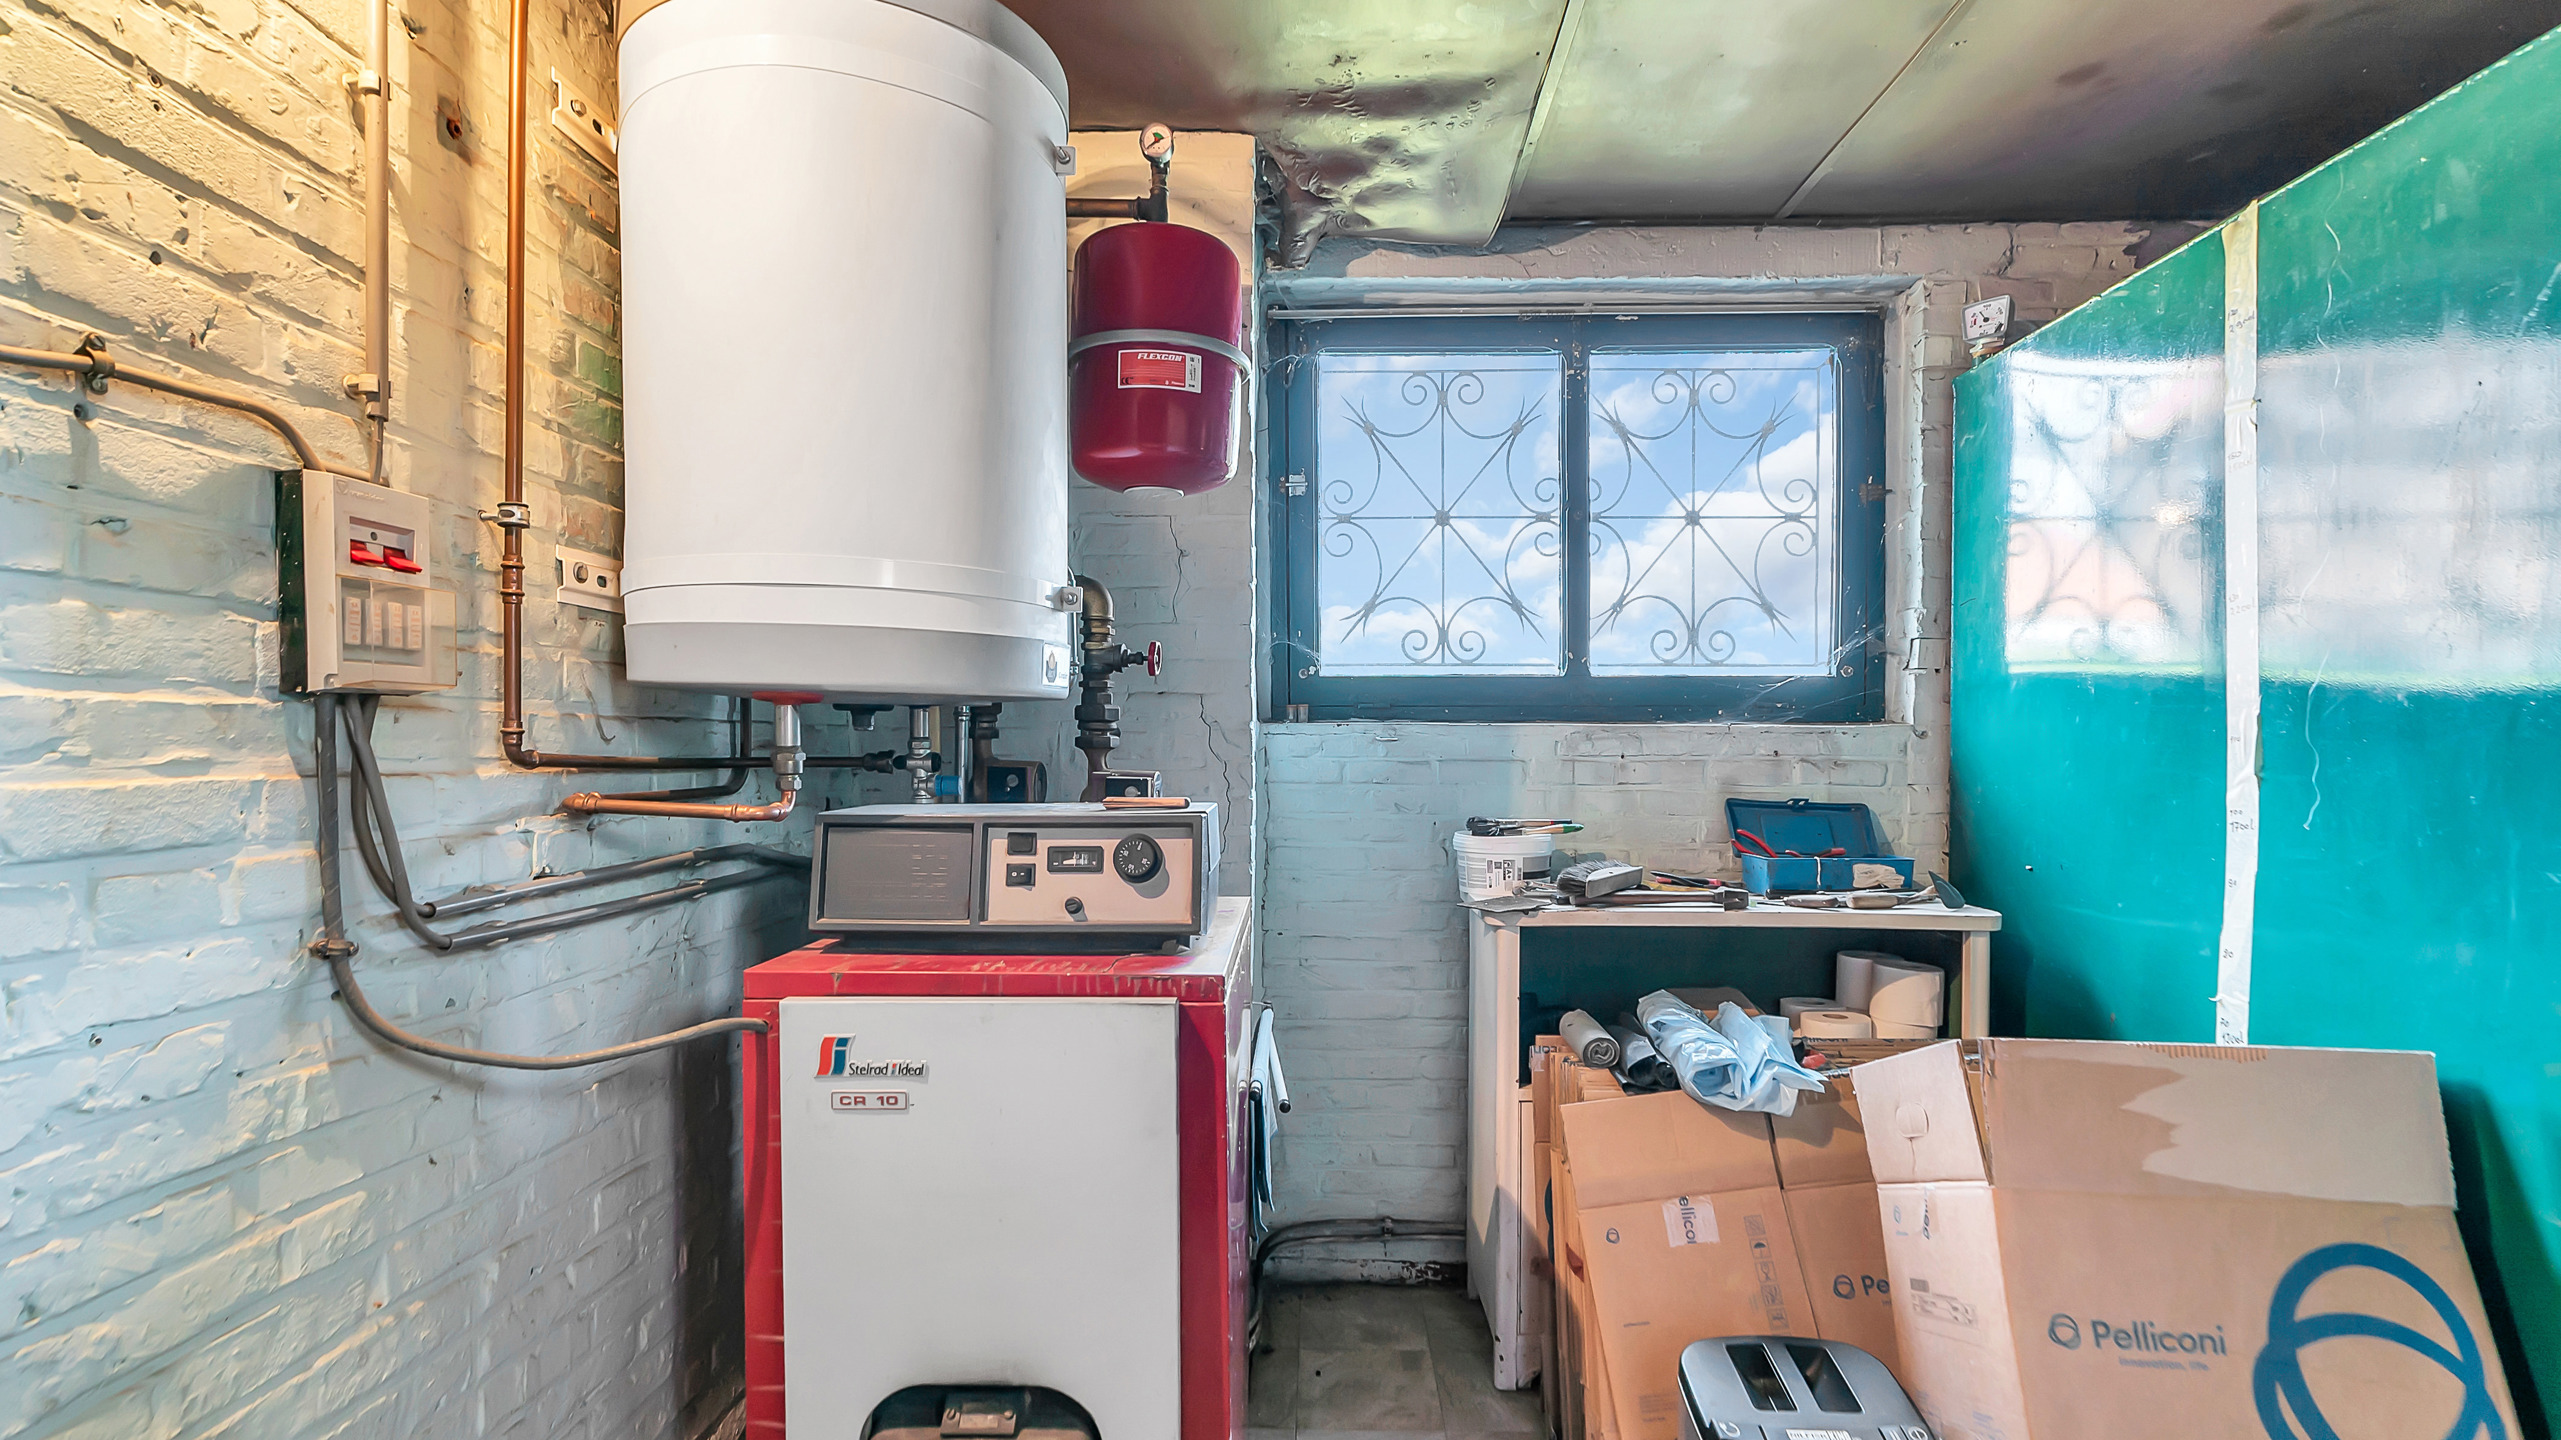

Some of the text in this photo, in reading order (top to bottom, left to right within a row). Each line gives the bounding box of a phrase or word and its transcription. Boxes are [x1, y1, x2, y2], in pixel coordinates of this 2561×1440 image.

[1137, 352, 1183, 362] FLEXCON
[848, 1062, 925, 1076] Stelrad Ideal
[839, 1095, 898, 1106] CR 10
[2090, 1319, 2227, 1357] Pelliconi
